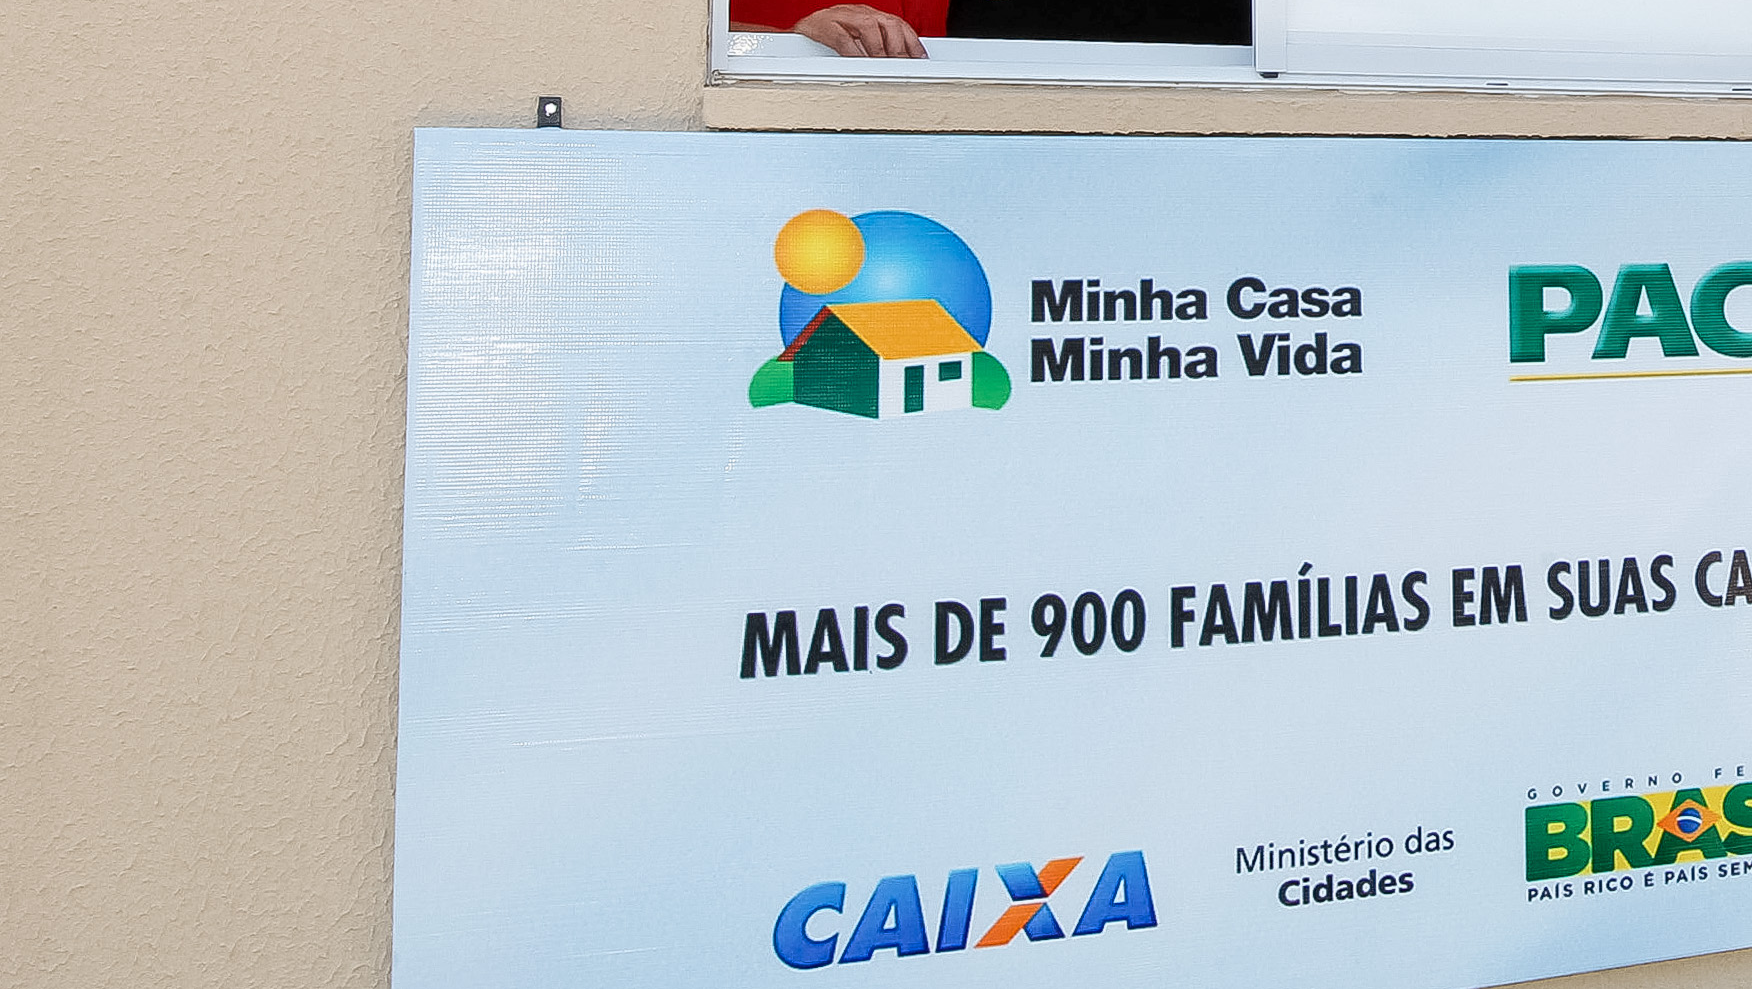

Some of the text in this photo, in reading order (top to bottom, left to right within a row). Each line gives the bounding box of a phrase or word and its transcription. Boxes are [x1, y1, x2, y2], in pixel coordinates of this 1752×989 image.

[1031, 277, 1363, 322] Minha Casa
[1031, 333, 1363, 382] Minha Vida
[740, 603, 908, 679] MAIS
[934, 597, 1007, 665] DE
[1030, 589, 1145, 658] 900
[1170, 562, 1430, 648] FAMÍLIAS
[1452, 564, 1527, 627] EM
[1547, 555, 1676, 619] SUAS
[1528, 772, 1682, 800] GOVERNO
[1236, 826, 1455, 877] Ministério das
[1277, 867, 1414, 907] Cidades
[1528, 881, 1574, 902] PAÍS
[1584, 875, 1634, 896] RICO
[1644, 872, 1655, 888] É
[1664, 866, 1708, 885] PAÍS
[773, 850, 1158, 970] CAIXA
